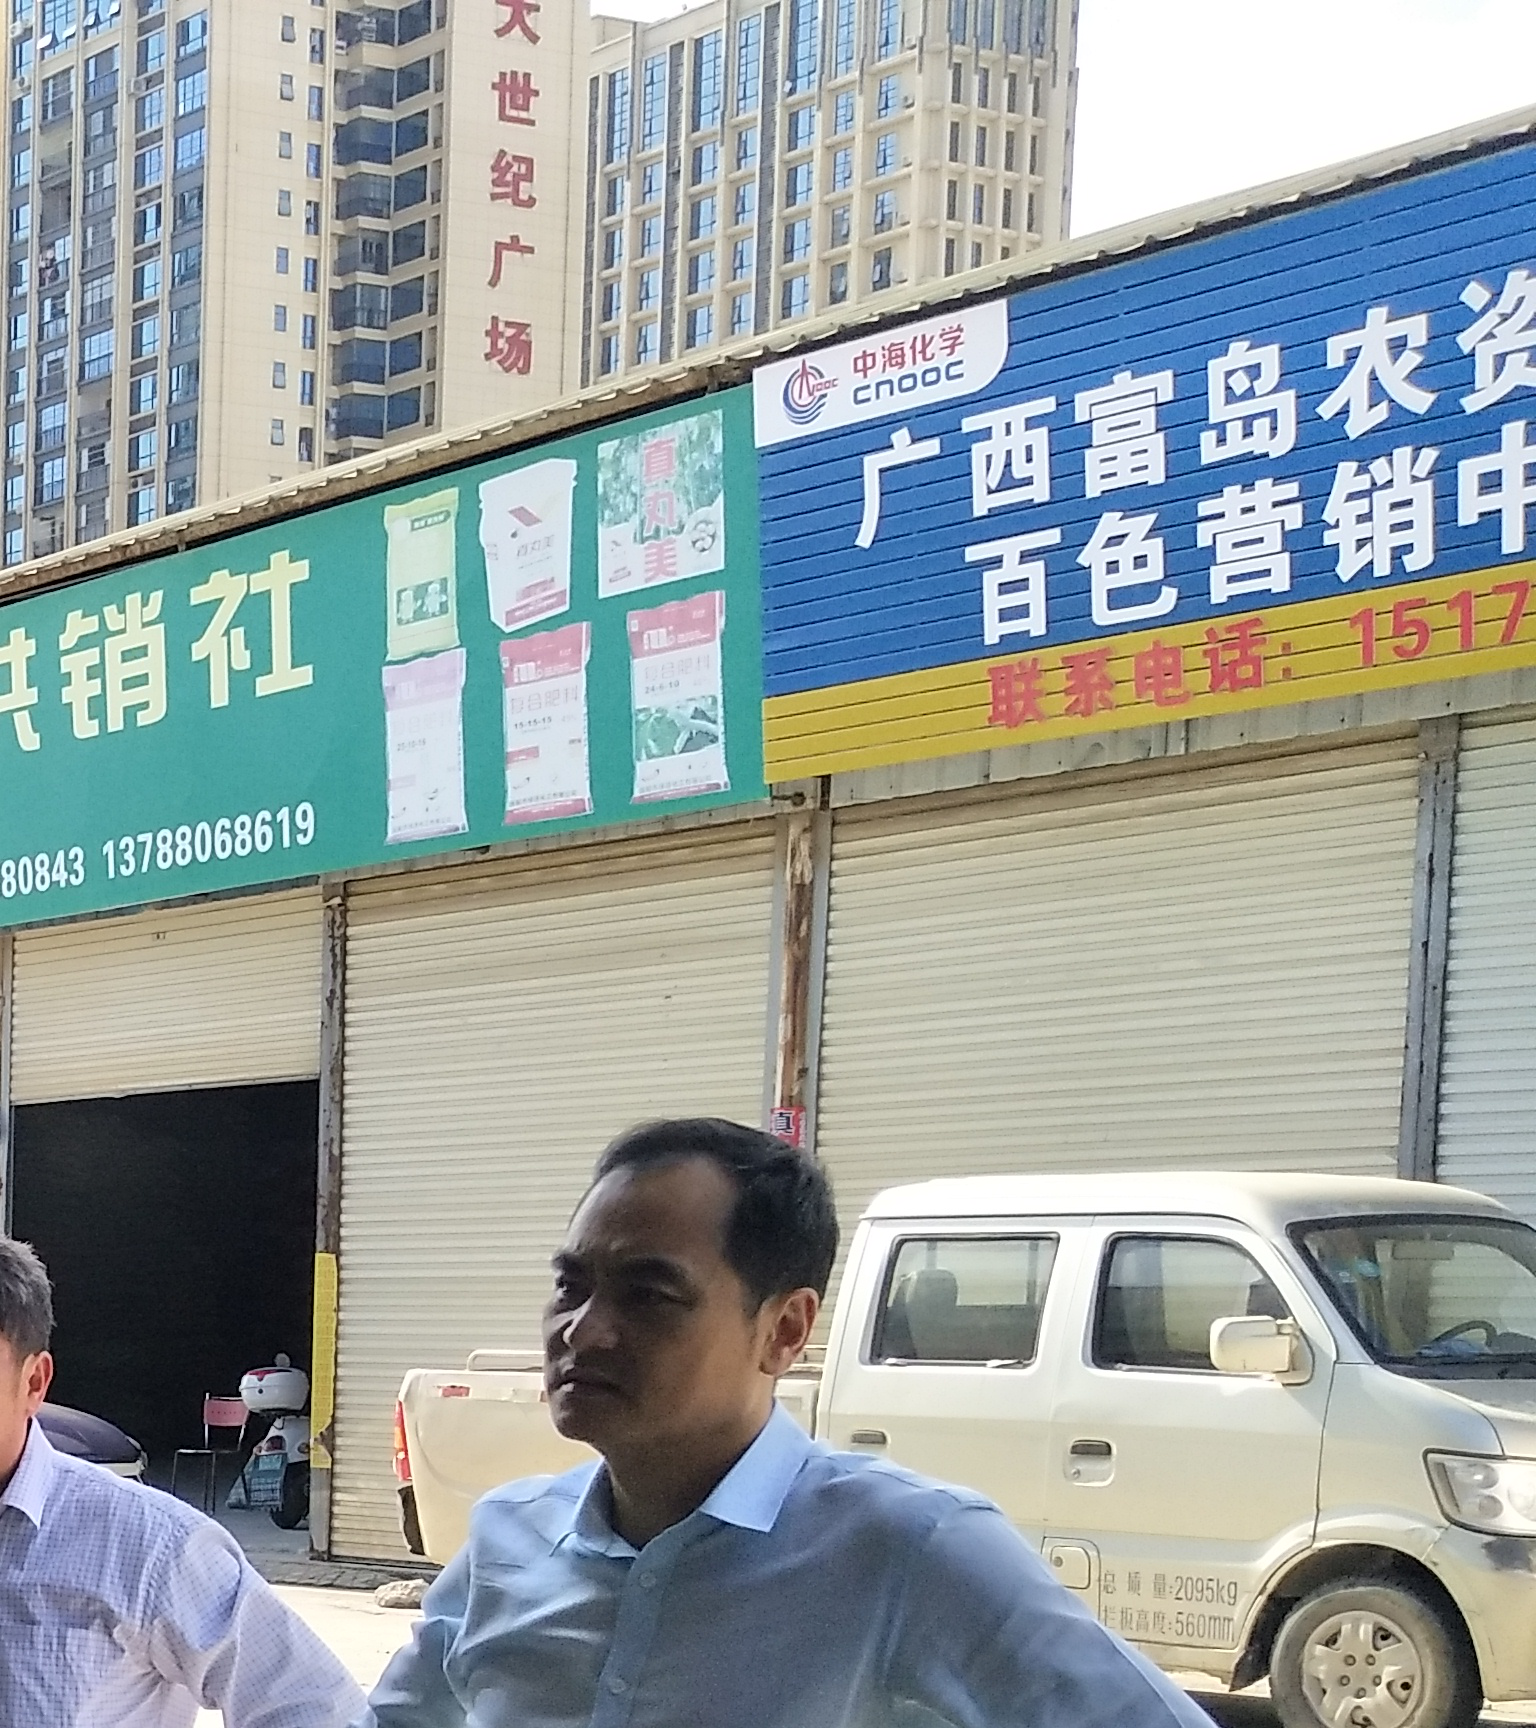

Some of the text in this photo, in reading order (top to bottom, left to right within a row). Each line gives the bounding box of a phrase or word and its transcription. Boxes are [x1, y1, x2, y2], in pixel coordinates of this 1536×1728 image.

[852, 323, 965, 379] 中海化学
[854, 269, 1536, 549] 广西富岛农资
[642, 436, 679, 581] 真丸美
[964, 419, 1536, 646] 百色营销中
[513, 715, 553, 730] 15-15-15
[101, 801, 316, 881] 13788068619
